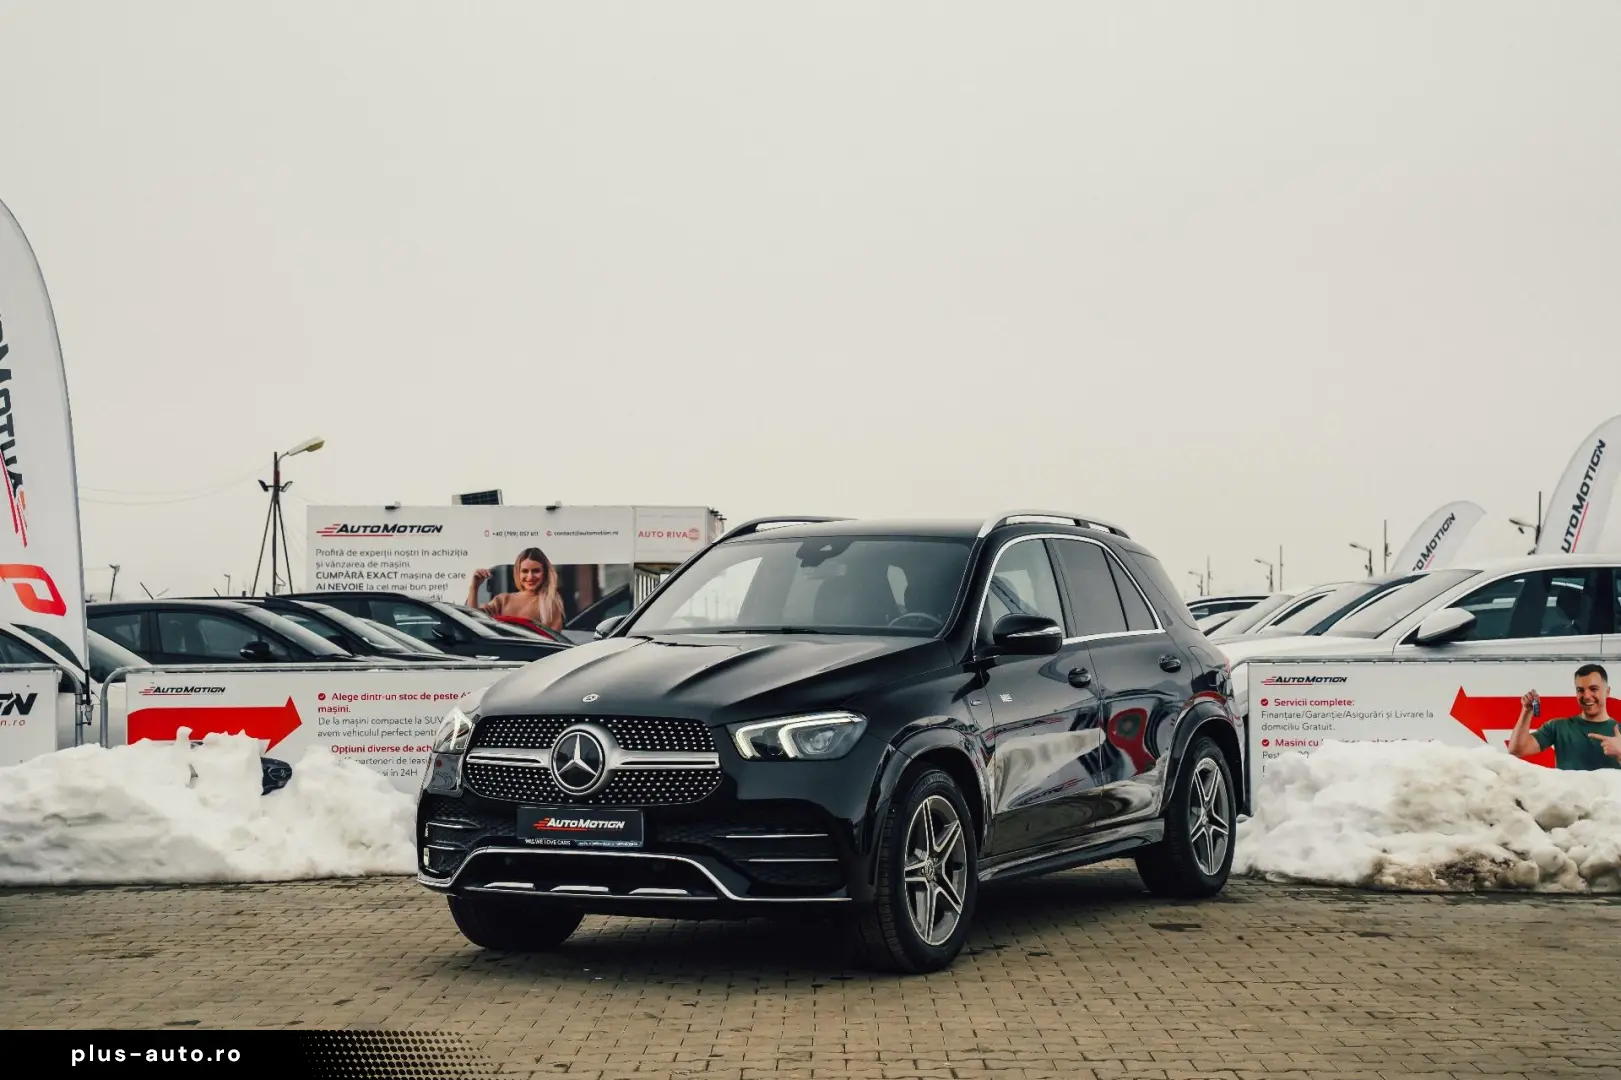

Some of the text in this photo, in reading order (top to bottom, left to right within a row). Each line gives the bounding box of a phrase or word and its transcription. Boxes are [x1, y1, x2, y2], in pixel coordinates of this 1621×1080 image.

[1561, 439, 1606, 553] UTOMOTION
[638, 530, 688, 538] AUTO RIVA
[360, 549, 392, 558] experții
[394, 549, 420, 558] noștri
[432, 549, 468, 558] achiziția
[367, 560, 378, 568] de
[316, 570, 364, 580] CUMPĂRĂ
[366, 572, 398, 580] EXACT
[400, 572, 432, 581] mașina
[316, 582, 326, 590] AI
[328, 582, 364, 590] NEVOIE
[332, 692, 358, 702] Alege
[360, 692, 396, 700] dintr-un
[420, 692, 431, 700] de
[433, 694, 458, 702] peste
[1274, 698, 1354, 708] Servicii complete:
[318, 704, 350, 714] mașini.
[1386, 710, 1392, 720] și
[1394, 710, 1424, 718] Livrare
[1426, 710, 1434, 718] la
[318, 716, 444, 728] De la mașini compacte la SUV
[1261, 722, 1336, 731] domiciliu Gratuit.
[343, 728, 380, 737] vehiculul
[381, 728, 412, 738] perfect
[332, 744, 432, 756] Opțiuni diverse de ach
[396, 756, 407, 764] de
[409, 756, 430, 764] leas
[1262, 752, 1280, 760] Pest
[400, 768, 418, 776] 24H
